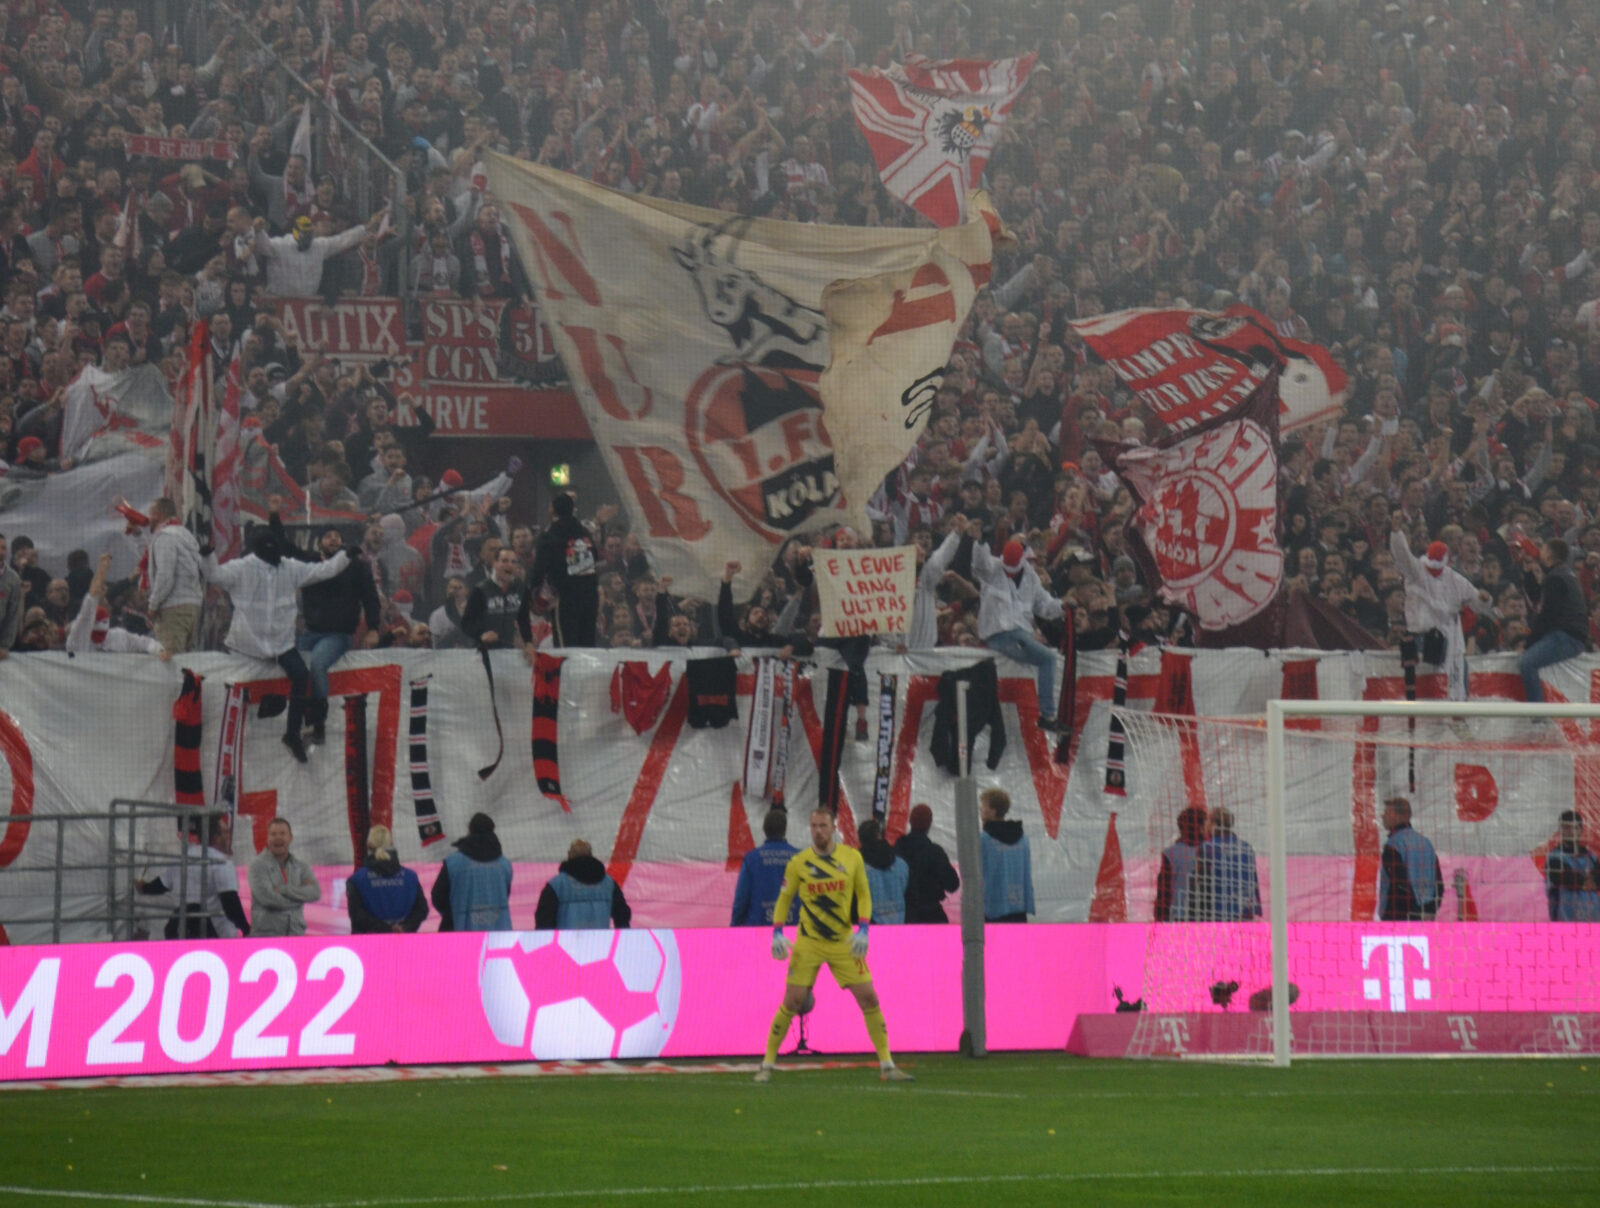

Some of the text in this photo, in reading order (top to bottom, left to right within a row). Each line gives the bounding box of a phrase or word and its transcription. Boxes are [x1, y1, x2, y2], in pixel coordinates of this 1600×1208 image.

[426, 302, 497, 339] SPS
[427, 344, 499, 381] CGN
[827, 558, 840, 576] E
[846, 578, 897, 595] LANG
[841, 595, 907, 617] ULTRAS
[886, 616, 905, 633] FC
[807, 879, 846, 896] REWE
[85, 945, 365, 1066] 2022
